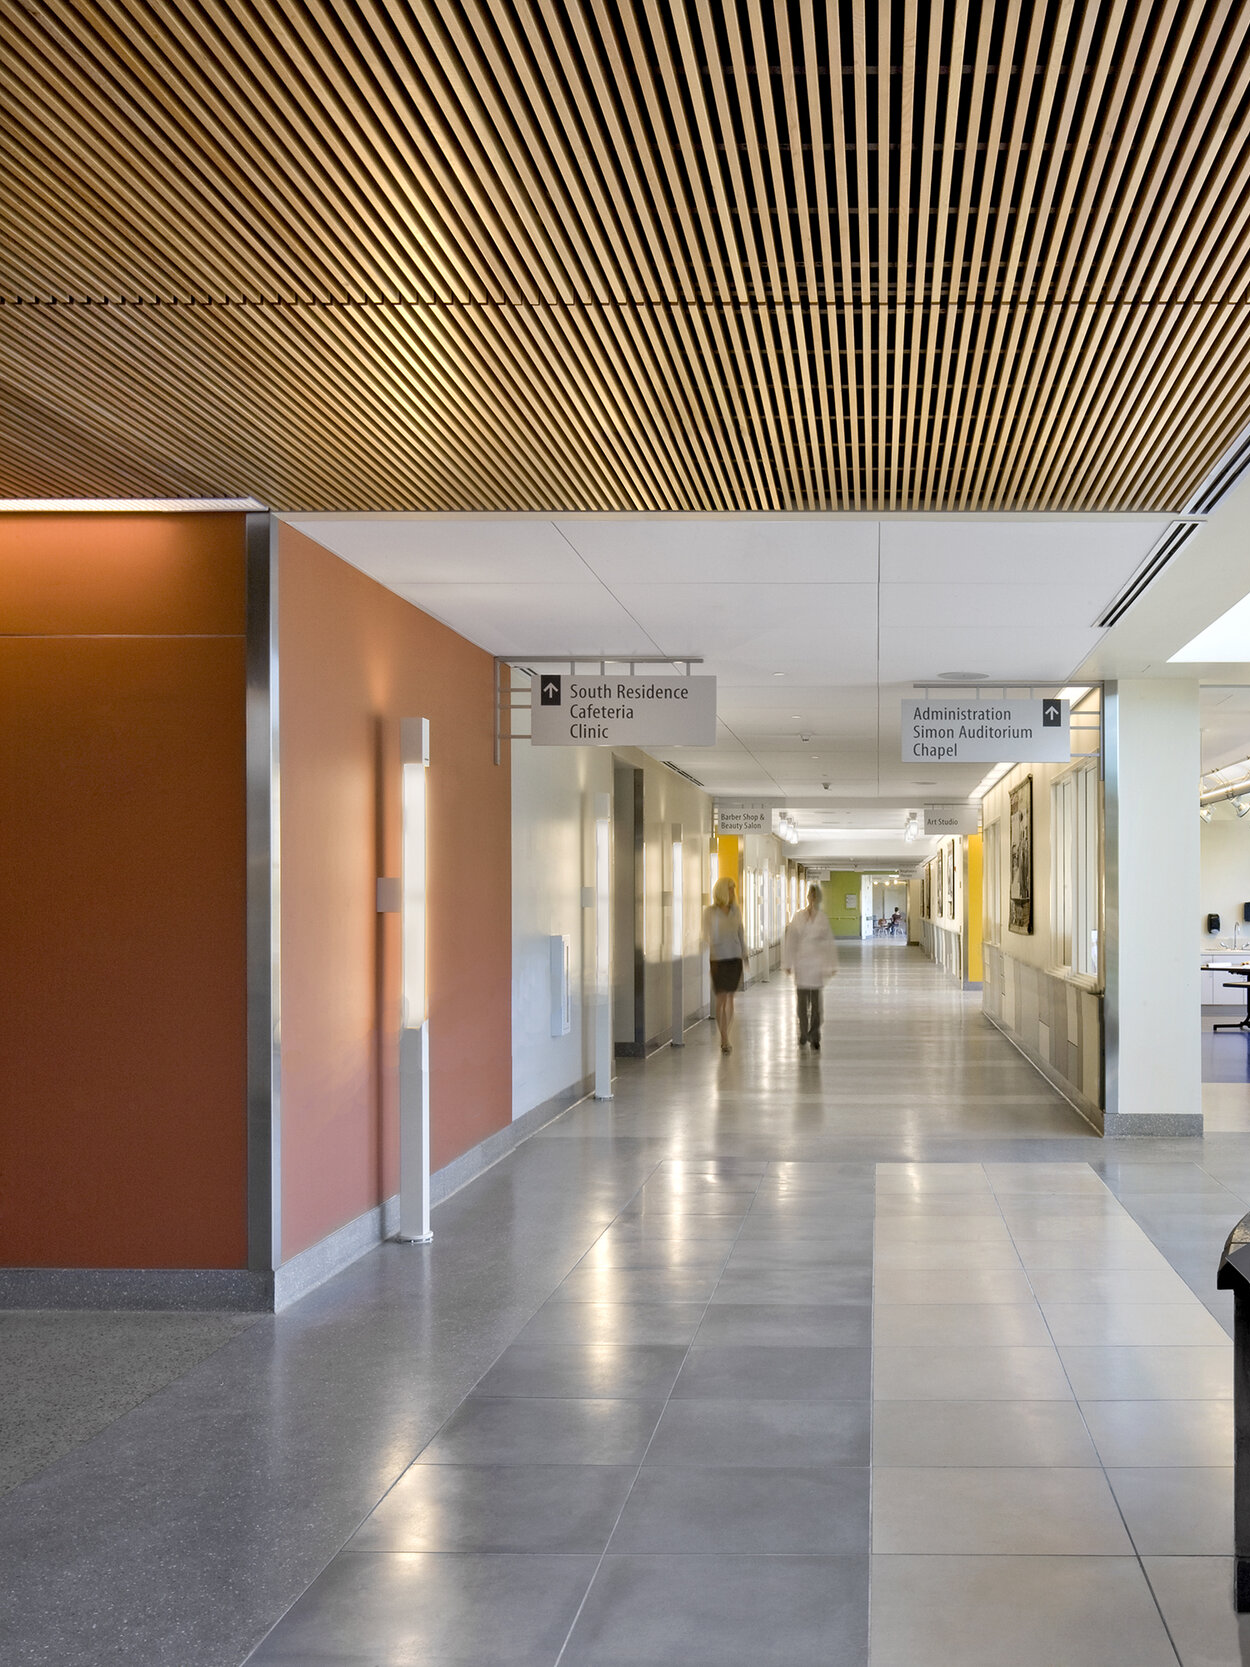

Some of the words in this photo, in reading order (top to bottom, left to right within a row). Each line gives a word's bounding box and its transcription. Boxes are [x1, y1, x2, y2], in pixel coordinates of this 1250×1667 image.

[569, 684, 612, 700] South
[617, 684, 689, 700] Residence
[569, 703, 634, 720] Cafeteria
[913, 707, 1012, 721] Administration
[569, 723, 609, 739] Clinic
[913, 725, 955, 739] Simon
[958, 725, 1033, 739] Auditorium
[913, 743, 958, 760] Chapel
[720, 813, 742, 821] Barber
[742, 813, 759, 822] Shop
[759, 813, 765, 821] &
[927, 818, 937, 826] Art
[938, 817, 959, 826] Studio
[720, 822, 743, 831] Beauty
[744, 822, 762, 830] Salon
